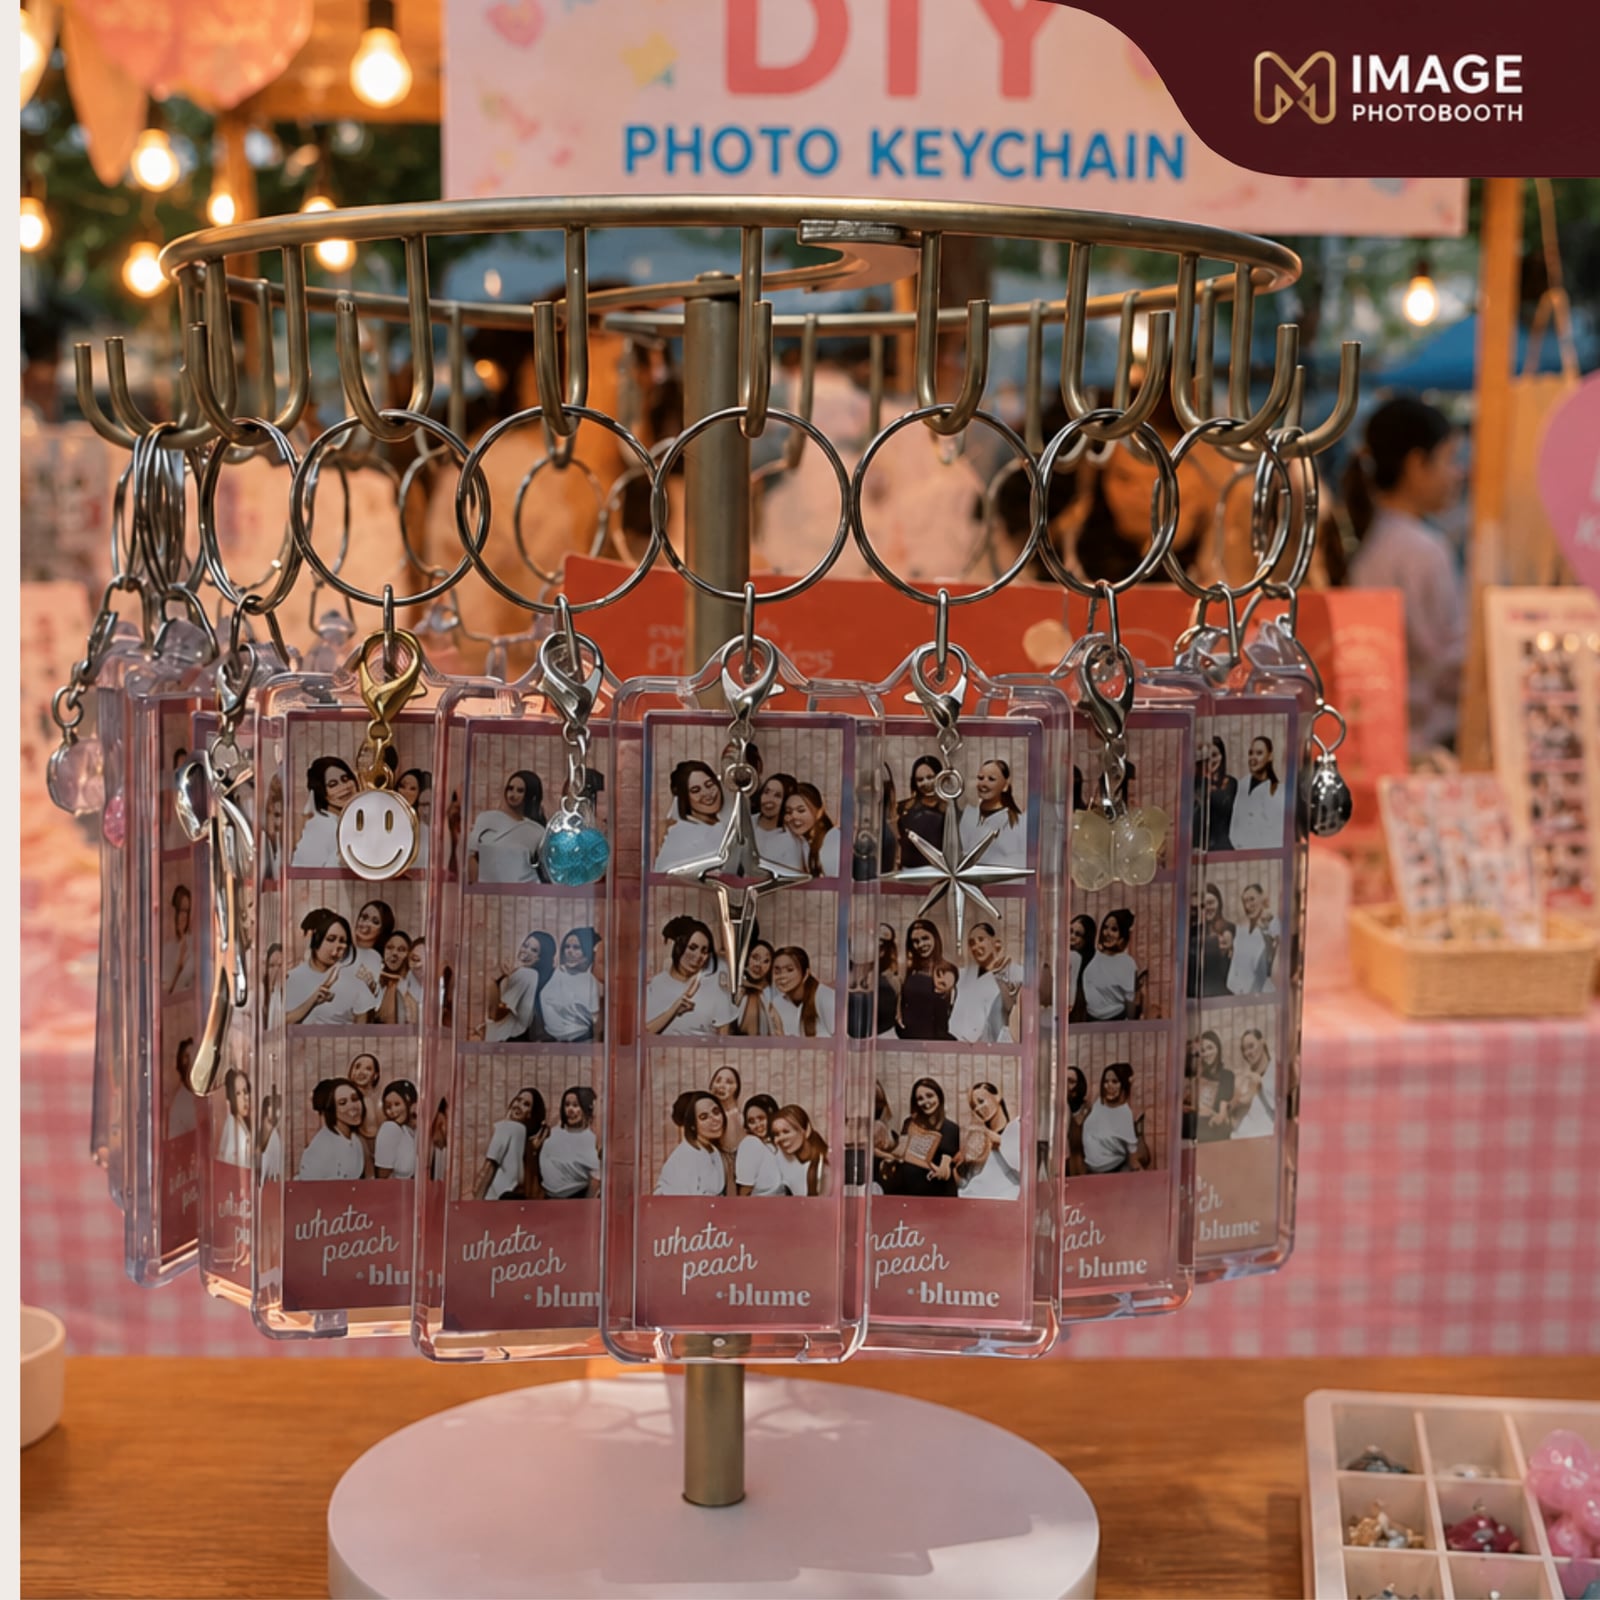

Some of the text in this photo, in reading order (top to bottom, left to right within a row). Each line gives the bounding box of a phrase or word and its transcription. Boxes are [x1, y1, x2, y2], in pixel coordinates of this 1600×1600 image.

[726, 0, 1058, 98] DIY
[623, 125, 1186, 181] PHOTO KEYCHAIN
[295, 1204, 374, 1240] whata
[653, 1221, 734, 1257] whata
[1063, 1220, 1106, 1252] ach
[1199, 1218, 1260, 1242] blume
[322, 1225, 399, 1277] peach
[462, 1224, 542, 1262] whata
[368, 1263, 410, 1286] blu
[490, 1248, 567, 1299] peach
[681, 1244, 758, 1296] peach
[874, 1244, 949, 1289] peach
[1078, 1255, 1148, 1280] blume
[536, 1284, 601, 1308] blum
[728, 1283, 811, 1307] blume
[919, 1281, 1000, 1308] blume
